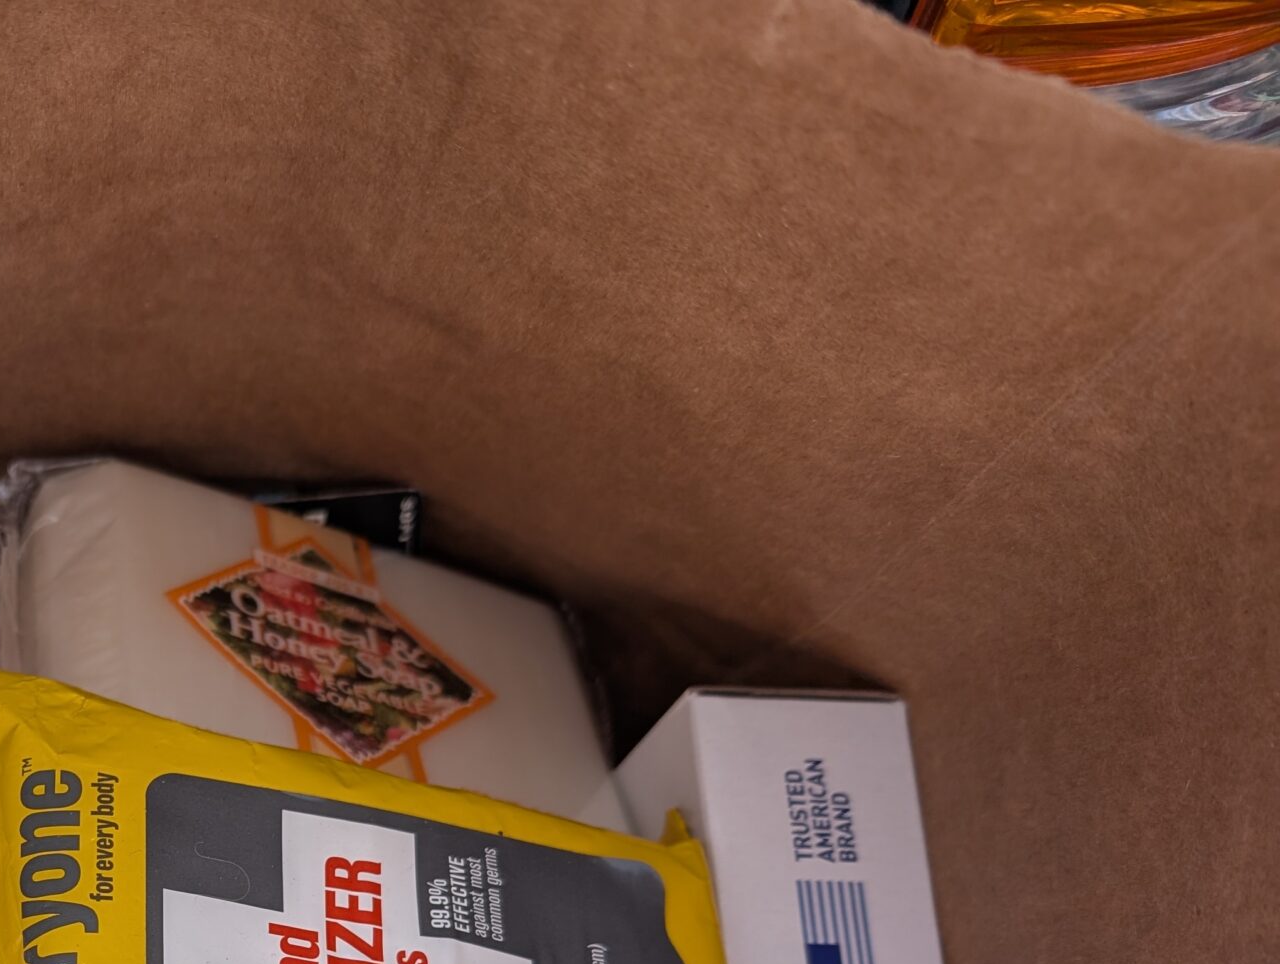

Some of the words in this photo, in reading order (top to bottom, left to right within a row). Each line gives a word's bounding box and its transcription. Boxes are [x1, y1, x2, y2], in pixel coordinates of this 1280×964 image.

[225, 610, 350, 676] Honey
[231, 587, 378, 657] Oatmeal
[391, 637, 433, 669] &
[249, 653, 306, 683] PURE
[315, 687, 374, 715] SOAP
[91, 772, 119, 816] body
[785, 770, 813, 861] TRUSTED
[805, 759, 835, 862] AMERICAN
[96, 819, 119, 871] every
[831, 793, 858, 862] BRAND
[89, 873, 114, 902] for
[467, 857, 483, 888] most
[484, 848, 503, 886] germs
[427, 879, 451, 928] 99.9%
[448, 856, 470, 933] EFFECTIVE
[469, 891, 490, 938] against
[488, 888, 504, 942] common
